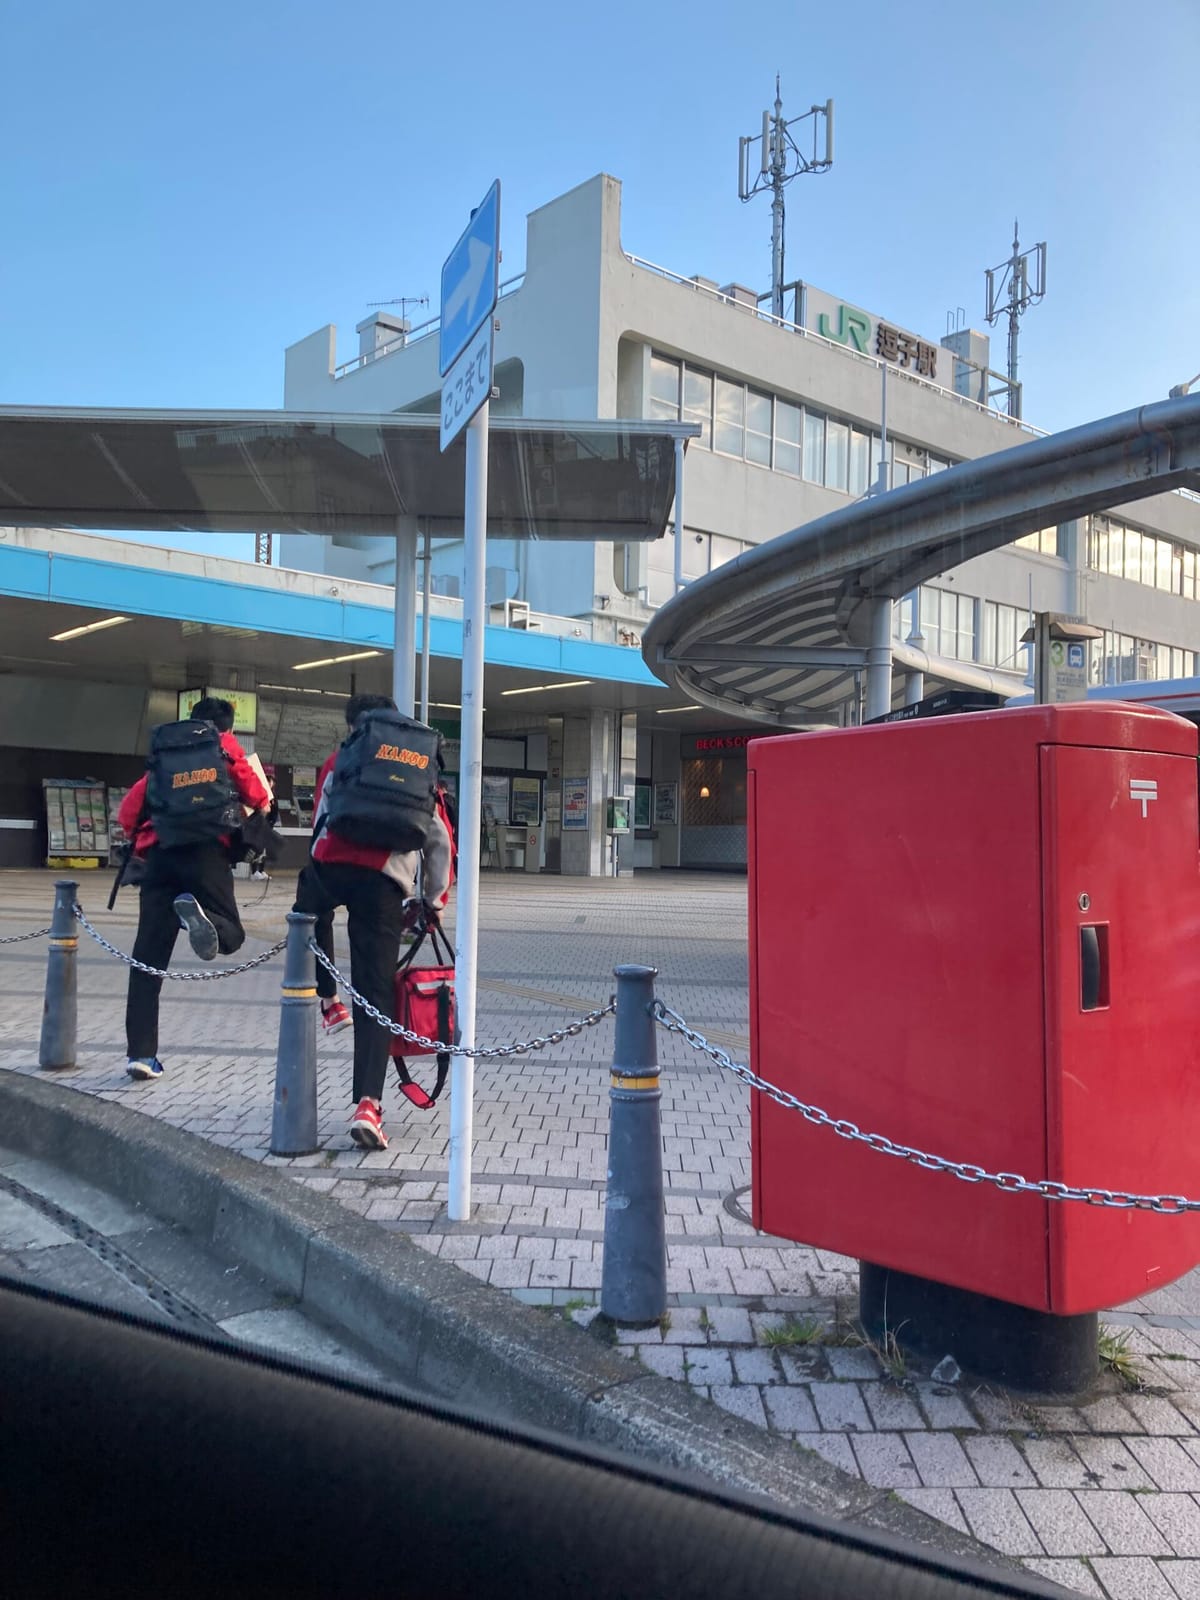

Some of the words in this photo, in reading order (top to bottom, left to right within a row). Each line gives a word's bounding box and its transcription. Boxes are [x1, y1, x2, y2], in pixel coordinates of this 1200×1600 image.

[818, 304, 872, 355] JR
[876, 323, 937, 379] 逗子駅
[443, 341, 488, 430] ここまで
[1051, 643, 1064, 667] 3
